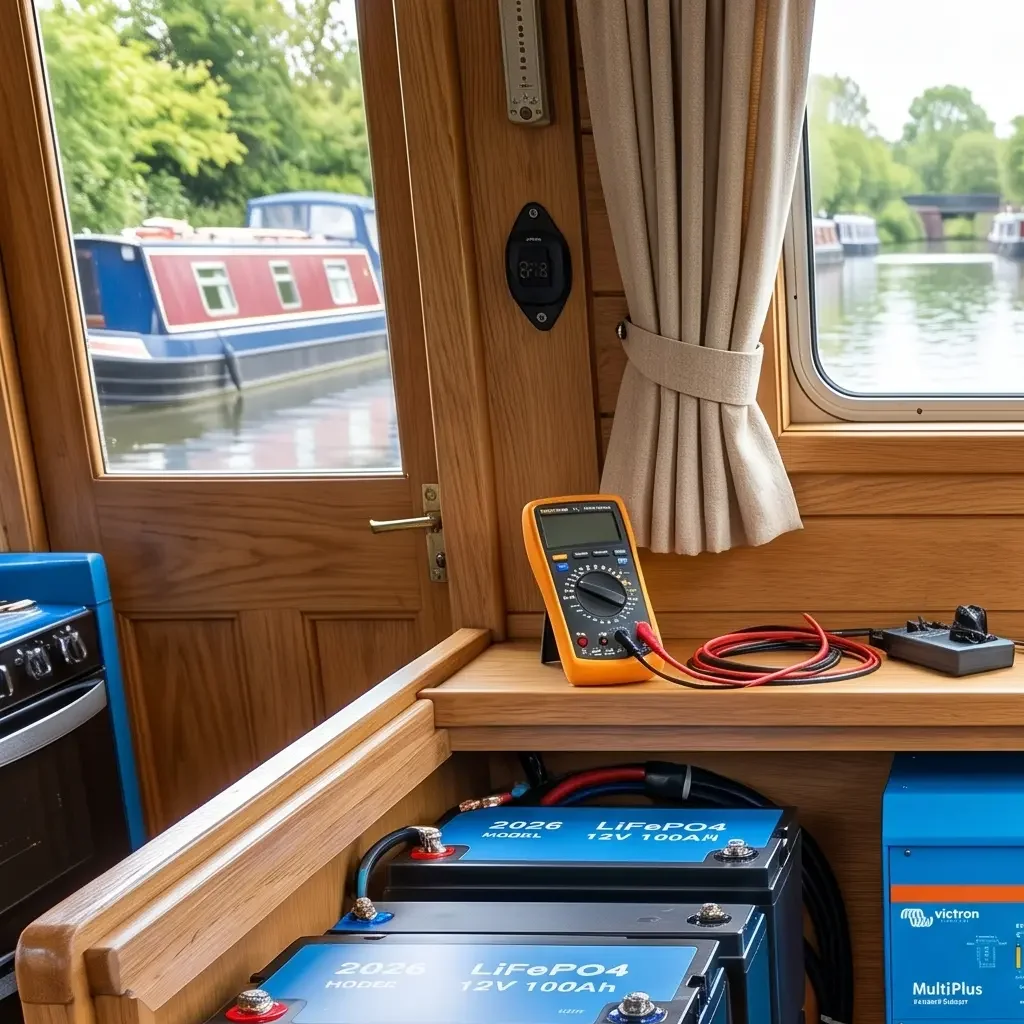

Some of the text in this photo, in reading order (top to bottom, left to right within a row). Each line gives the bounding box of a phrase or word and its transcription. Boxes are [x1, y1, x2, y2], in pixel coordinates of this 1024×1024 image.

[489, 821, 563, 830] 2026
[596, 821, 727, 832] LiFePO4
[587, 833, 632, 841] 12V
[935, 908, 980, 919] victron
[334, 962, 426, 976] 2026
[471, 963, 629, 977] LiFePO4
[461, 981, 616, 993] 12V 100Ah
[913, 981, 983, 996] MultiPlus
